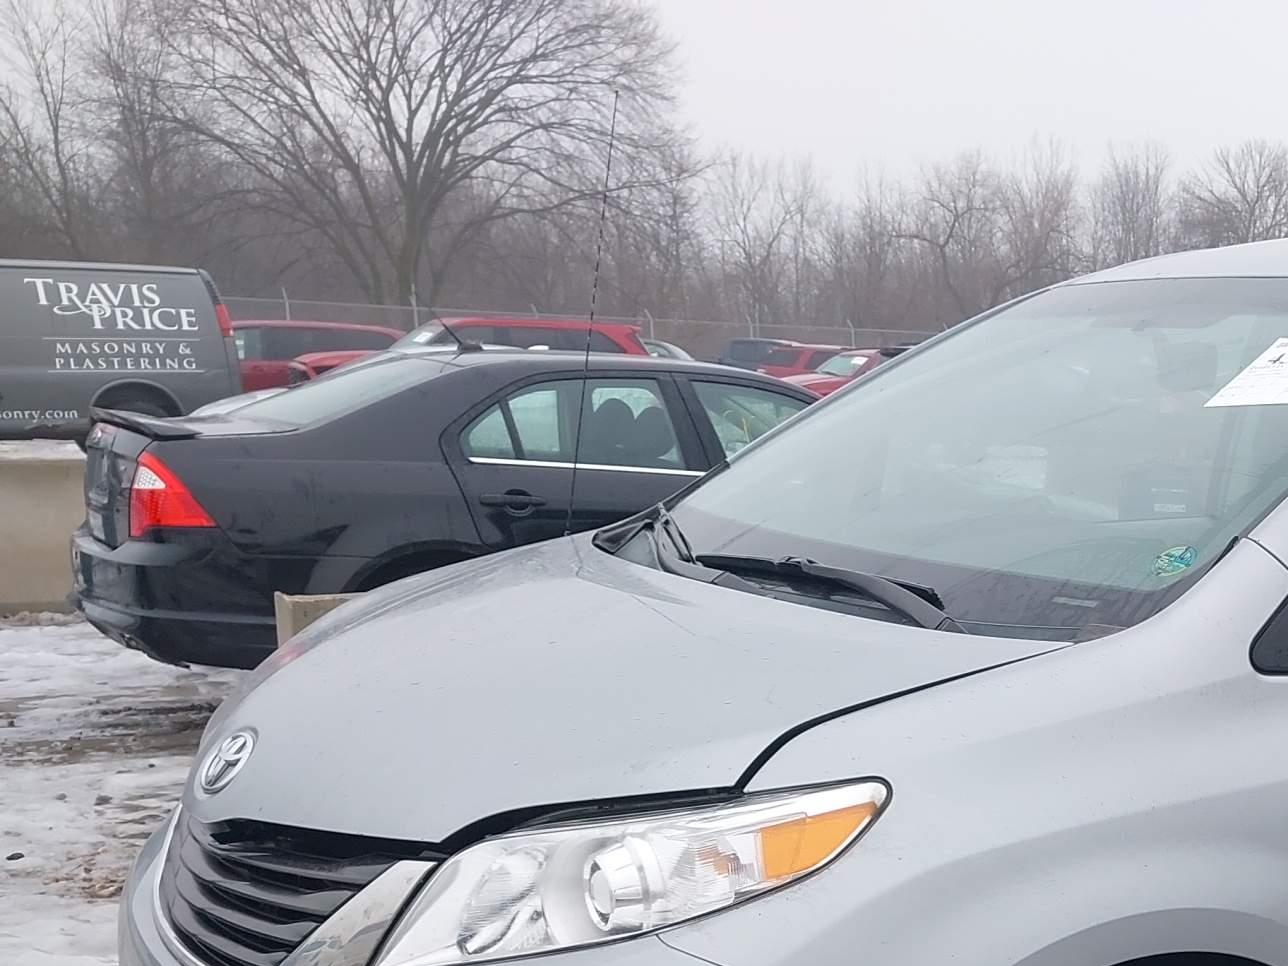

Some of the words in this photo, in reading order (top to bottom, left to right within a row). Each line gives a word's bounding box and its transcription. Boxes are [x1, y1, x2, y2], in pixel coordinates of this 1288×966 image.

[24, 278, 161, 310] TRAVIS
[91, 304, 199, 331] PRICE
[55, 342, 167, 355] MASONRY
[179, 342, 193, 355] &
[55, 357, 198, 370] PLASTERING
[0, 409, 79, 423] onry.com
